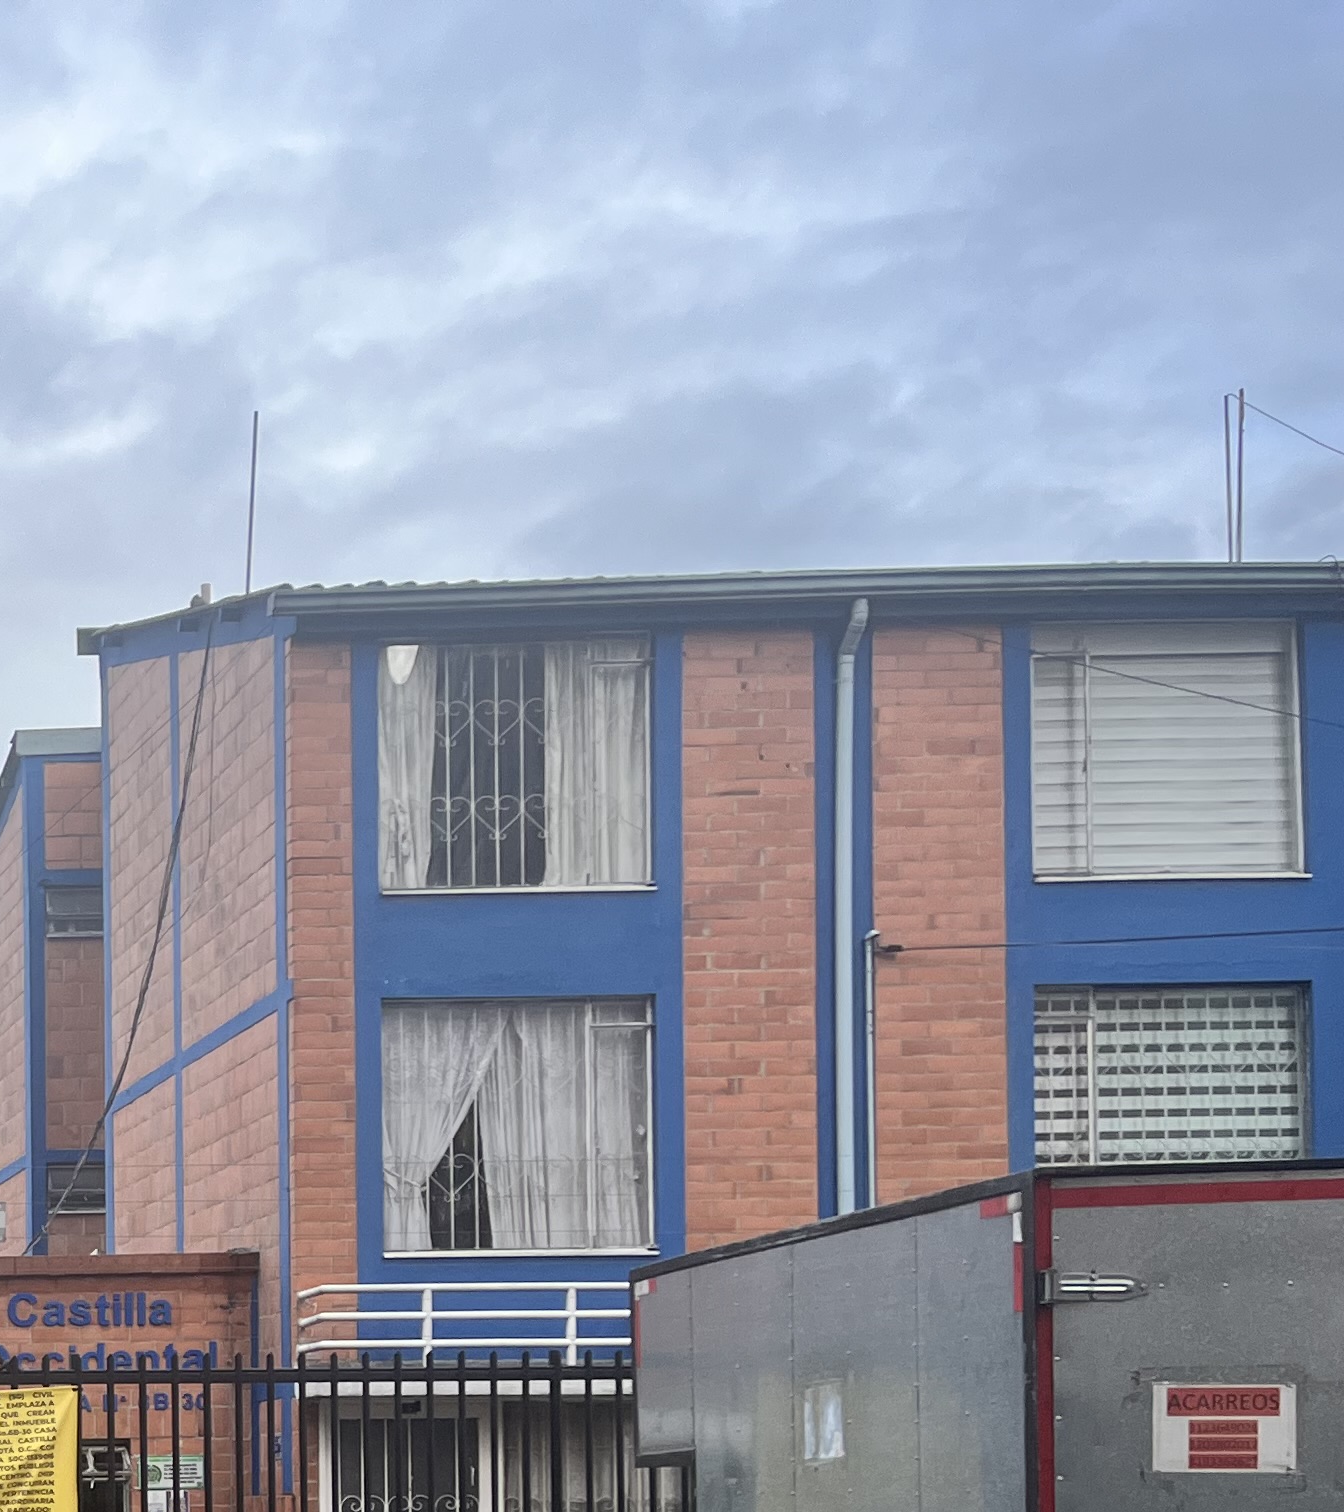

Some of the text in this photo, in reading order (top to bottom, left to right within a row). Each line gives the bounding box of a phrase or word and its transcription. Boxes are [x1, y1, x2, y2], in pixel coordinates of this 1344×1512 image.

[7, 1292, 172, 1327] Castilla
[7, 1401, 46, 1409] EMPLAZA
[1168, 1394, 1280, 1411] ACARREOS
[13, 1418, 56, 1426] INMUEBLE
[18, 1436, 56, 1444] CASTILLA
